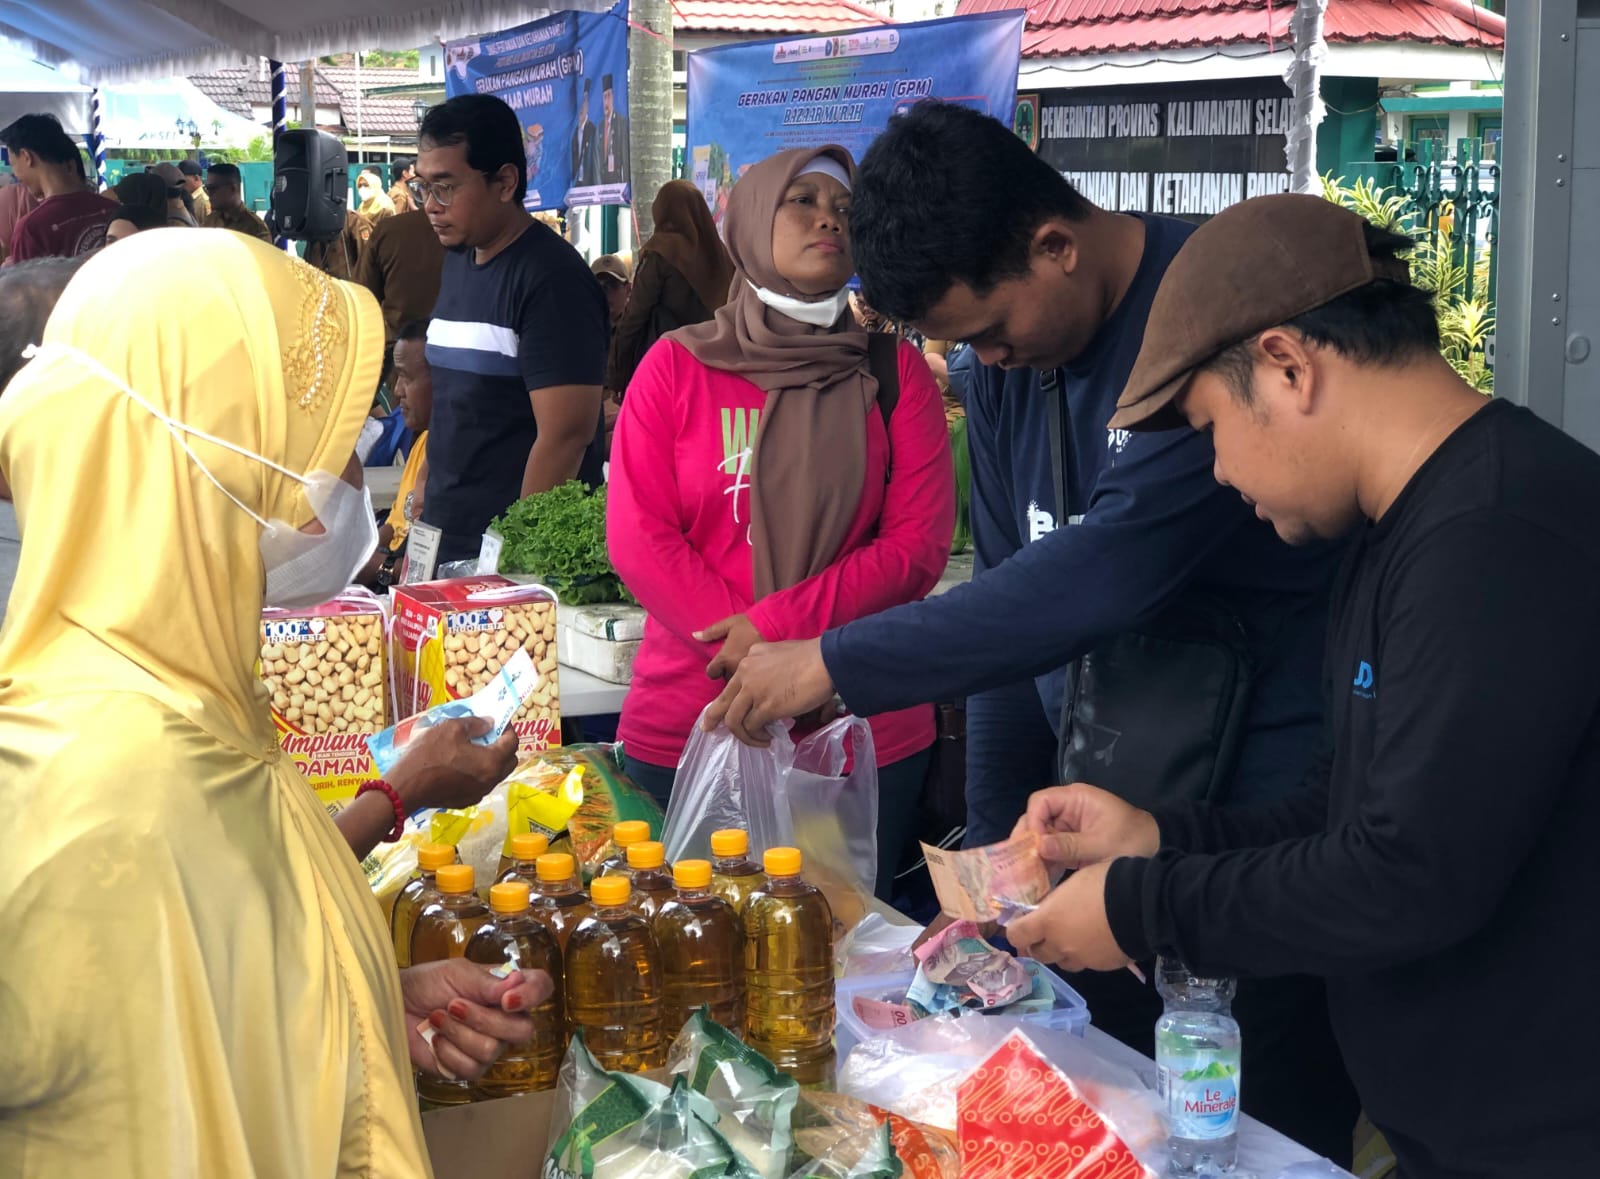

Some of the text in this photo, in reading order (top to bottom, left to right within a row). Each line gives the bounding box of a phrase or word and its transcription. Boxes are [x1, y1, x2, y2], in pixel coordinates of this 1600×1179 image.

[501, 67, 530, 88] PANGAN
[530, 60, 559, 83] MURAH
[503, 84, 553, 111] ZAAR MURAH
[737, 91, 787, 107] GERAKAN
[791, 85, 840, 103] PANGAN
[843, 80, 888, 100] MURAH
[892, 76, 933, 98] (GPM)
[1041, 103, 1106, 139] PEMERINTAH
[1108, 102, 1159, 137] PROVINS
[1167, 98, 1251, 136] KALIMANTAN
[1062, 171, 1293, 214] TANIAN DAN KETAHANAN PANG
[721, 408, 760, 474] W
[266, 634, 327, 643] INDONESIA
[448, 622, 506, 633] INDONESIA
[513, 718, 552, 740] ang
[280, 731, 372, 758] Amplang
[310, 781, 336, 791] URIH,
[1184, 1095, 1236, 1113] Minerale
[1205, 1088, 1221, 1102] Le
